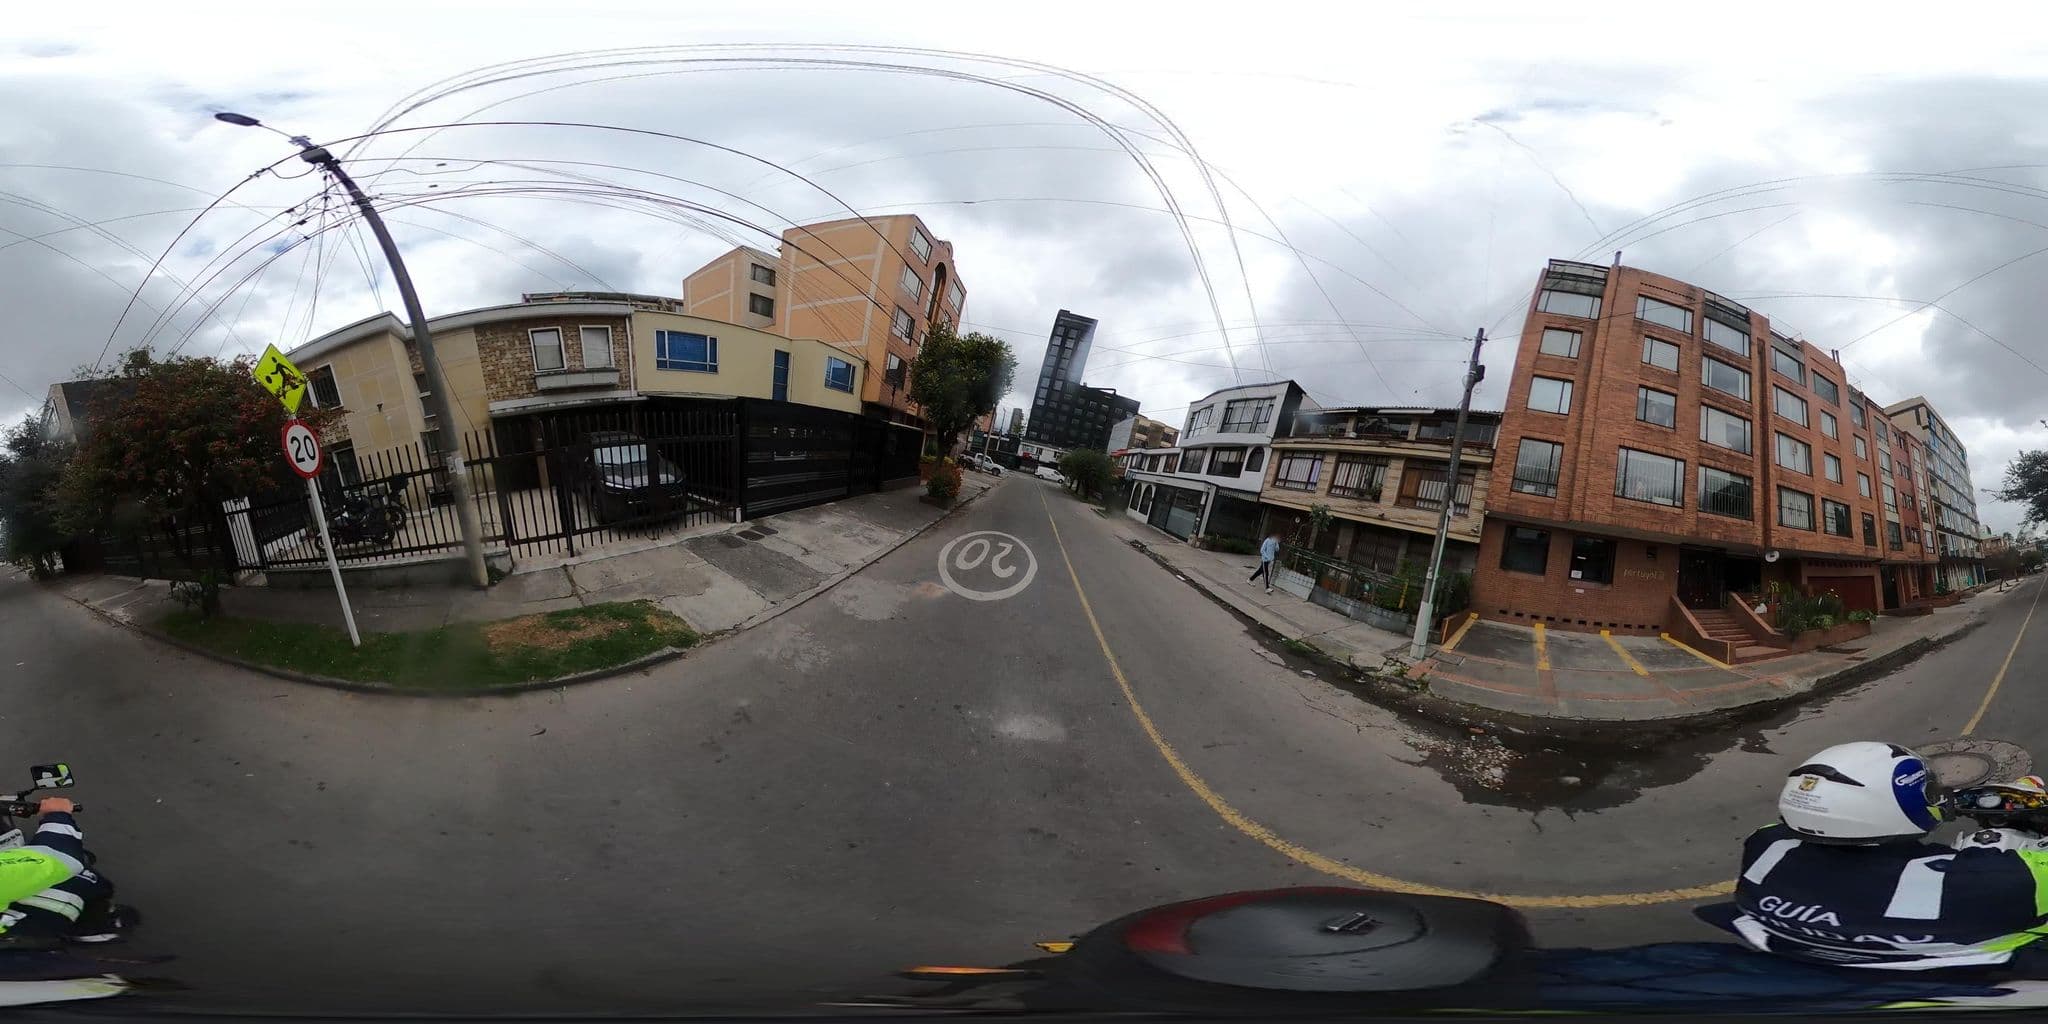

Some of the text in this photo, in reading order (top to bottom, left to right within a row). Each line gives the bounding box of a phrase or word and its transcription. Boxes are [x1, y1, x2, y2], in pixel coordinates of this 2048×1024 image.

[290, 435, 316, 463] 20
[955, 538, 1017, 578] 20
[1758, 895, 1841, 927] GUÍA
